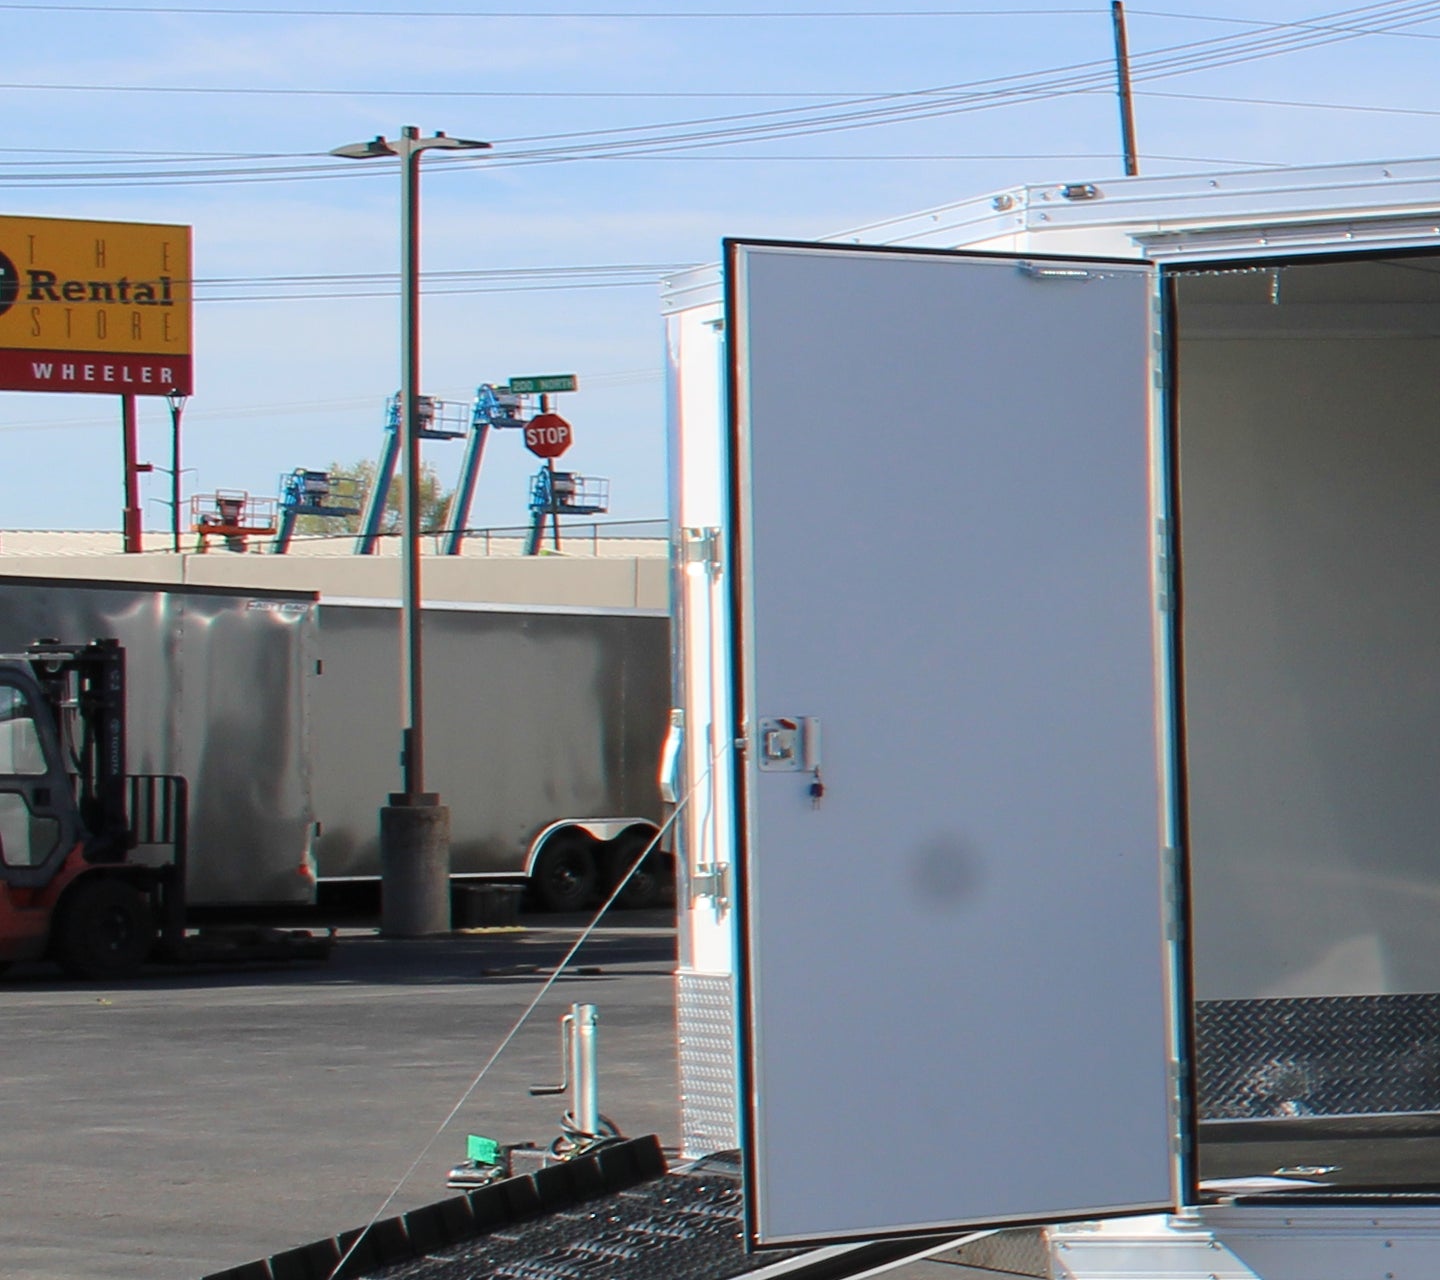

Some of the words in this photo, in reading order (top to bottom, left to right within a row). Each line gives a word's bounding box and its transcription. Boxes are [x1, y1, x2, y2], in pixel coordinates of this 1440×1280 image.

[27, 234, 170, 272] THE
[26, 269, 174, 307] Rental
[31, 306, 171, 342] STORE
[32, 362, 173, 384] WHEELER
[526, 426, 568, 446] STOP
[111, 735, 120, 776] TOYOTA
